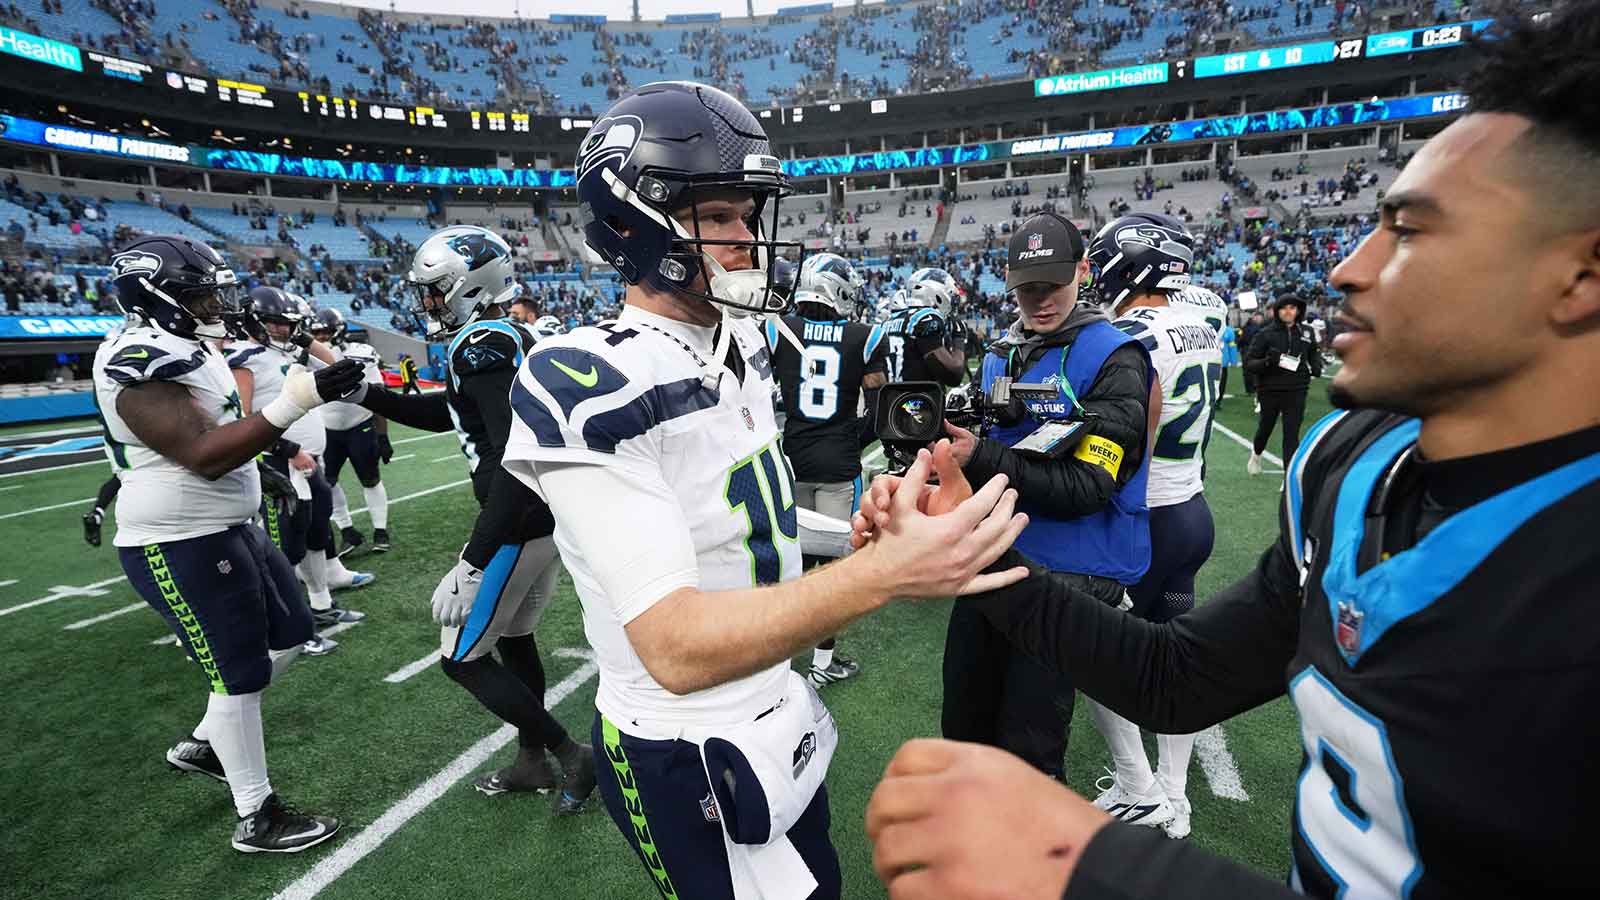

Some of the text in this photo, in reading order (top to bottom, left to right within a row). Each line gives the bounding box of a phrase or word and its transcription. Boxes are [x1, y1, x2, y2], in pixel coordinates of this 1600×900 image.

[1422, 26, 1462, 46] 0:23
[0, 32, 74, 65] Health
[1257, 49, 1271, 67] &
[1339, 39, 1362, 58] 27
[1053, 66, 1164, 95] Atrium Health
[45, 127, 189, 162] CAROLINA PANTHERS
[1011, 132, 1114, 154] CAROLINA PANTHERS
[1018, 248, 1054, 260] FILMS
[803, 323, 843, 342] HORN
[799, 346, 841, 420] 8
[1045, 403, 1065, 413] FILMS
[1089, 443, 1113, 459] WEEK
